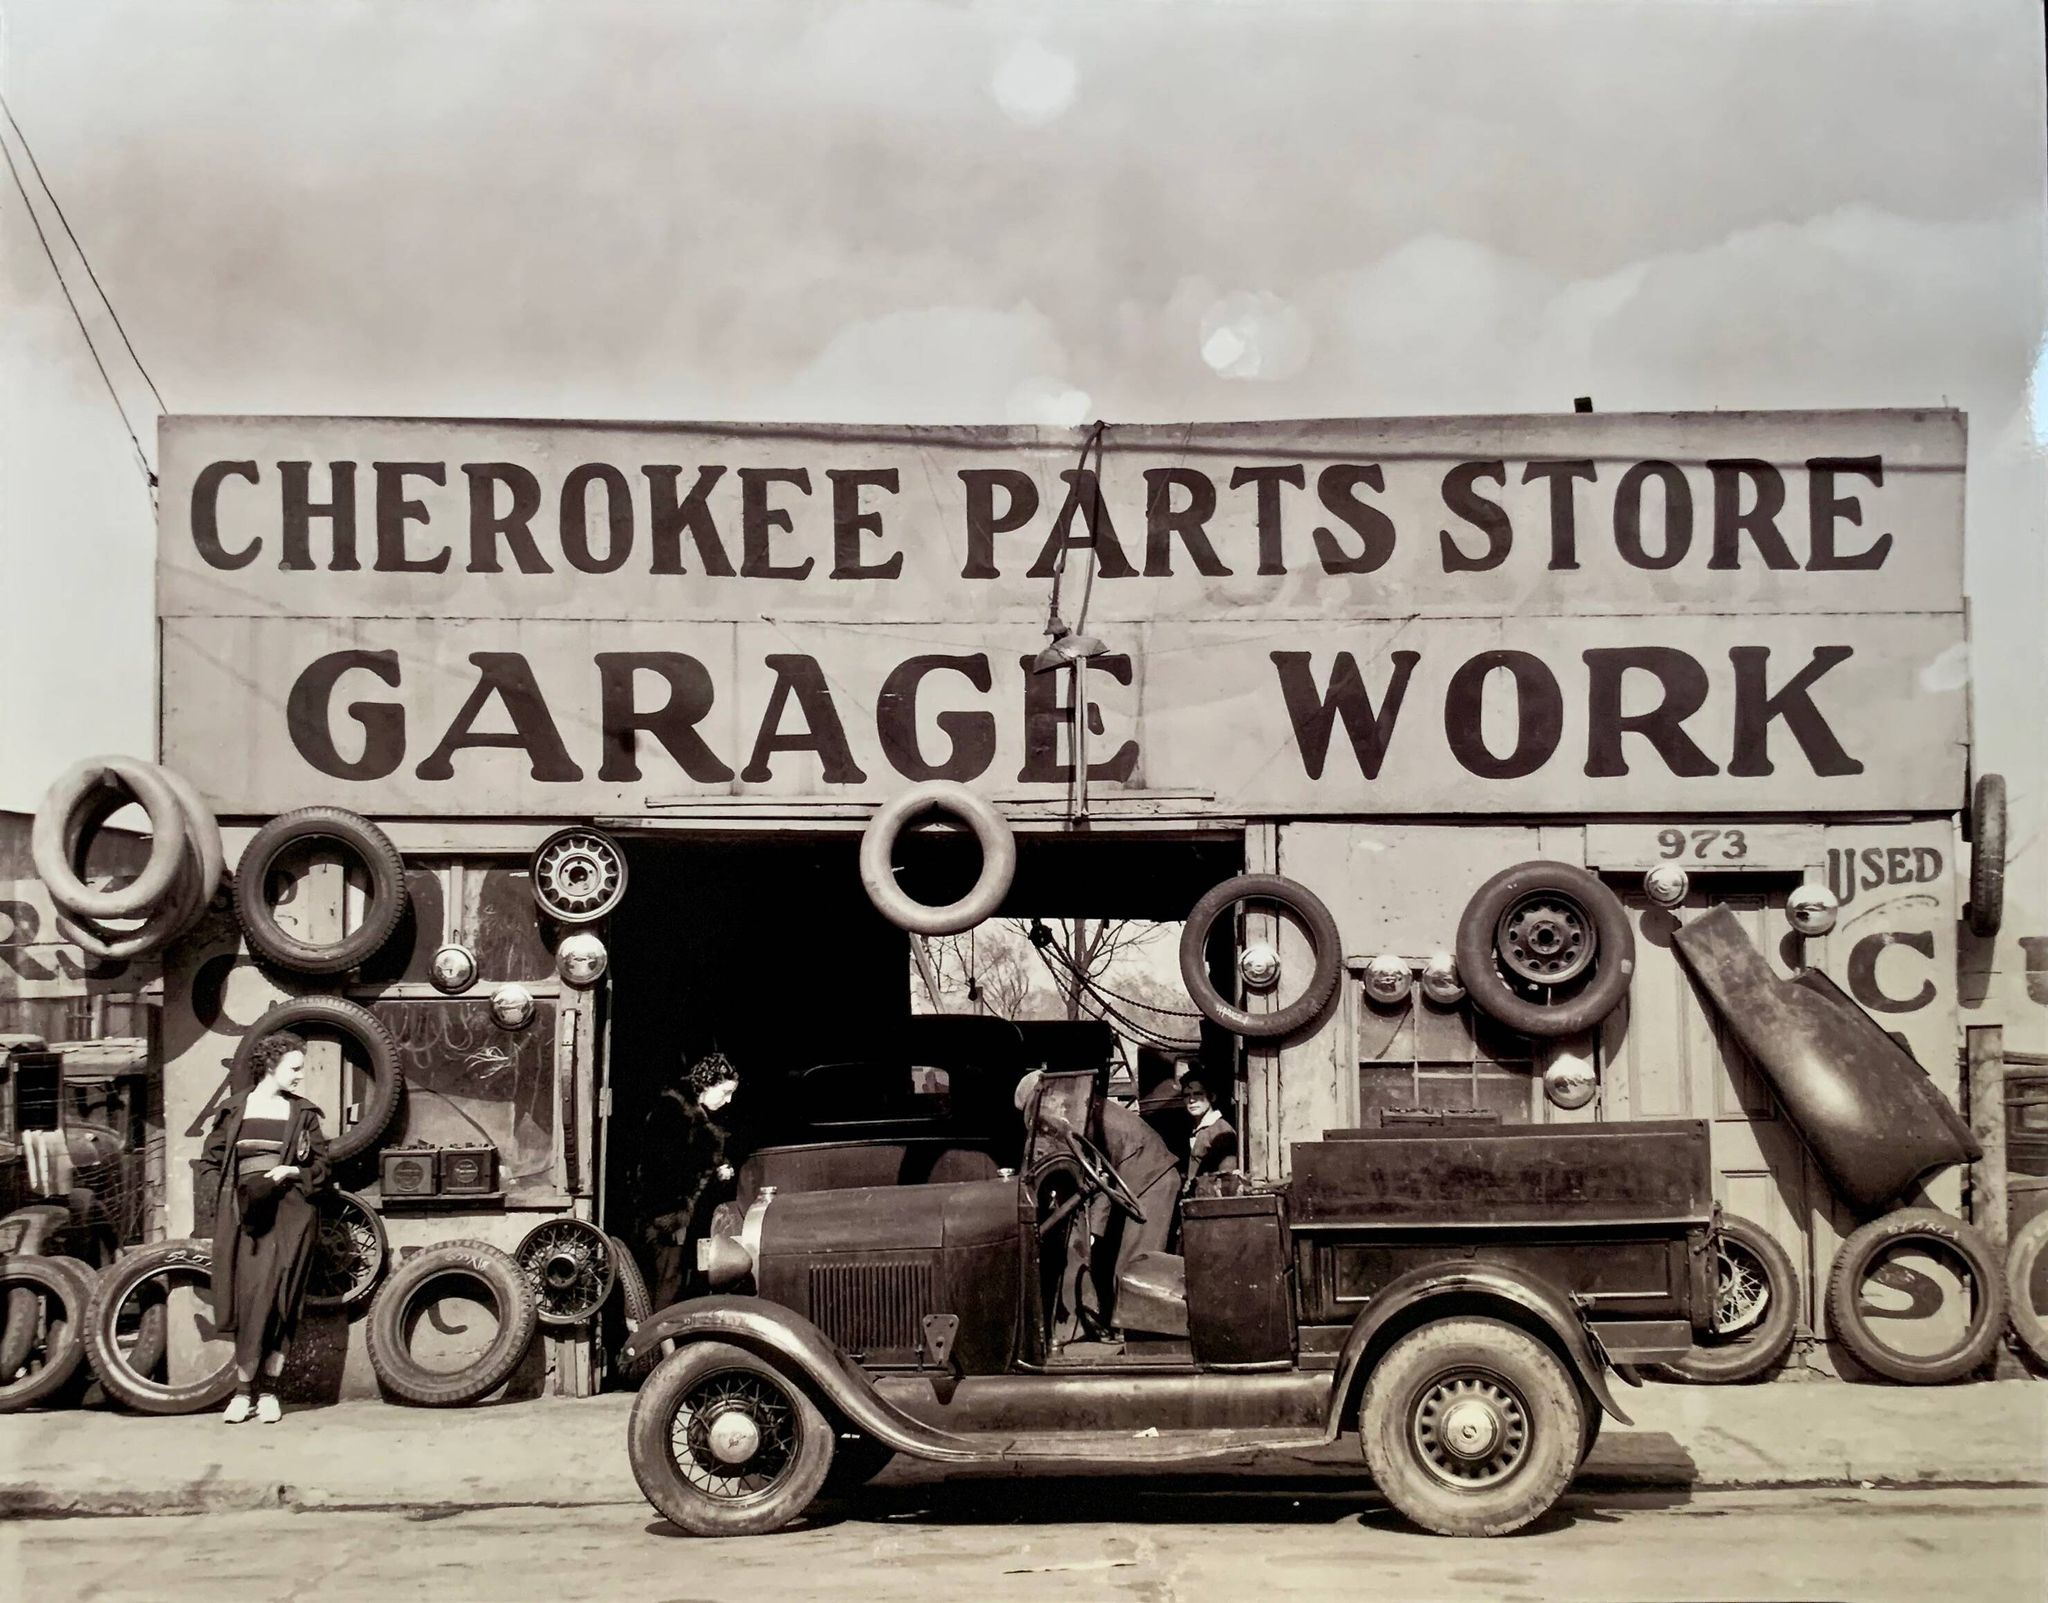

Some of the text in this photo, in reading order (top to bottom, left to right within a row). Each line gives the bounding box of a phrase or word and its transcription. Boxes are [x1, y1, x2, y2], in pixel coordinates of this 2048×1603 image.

[191, 455, 1893, 580] CHEROKEE PARTS STORE
[287, 645, 1864, 784] GARAGE WORK
[1657, 829, 1748, 859] 973
[1827, 847, 1944, 907] USED
